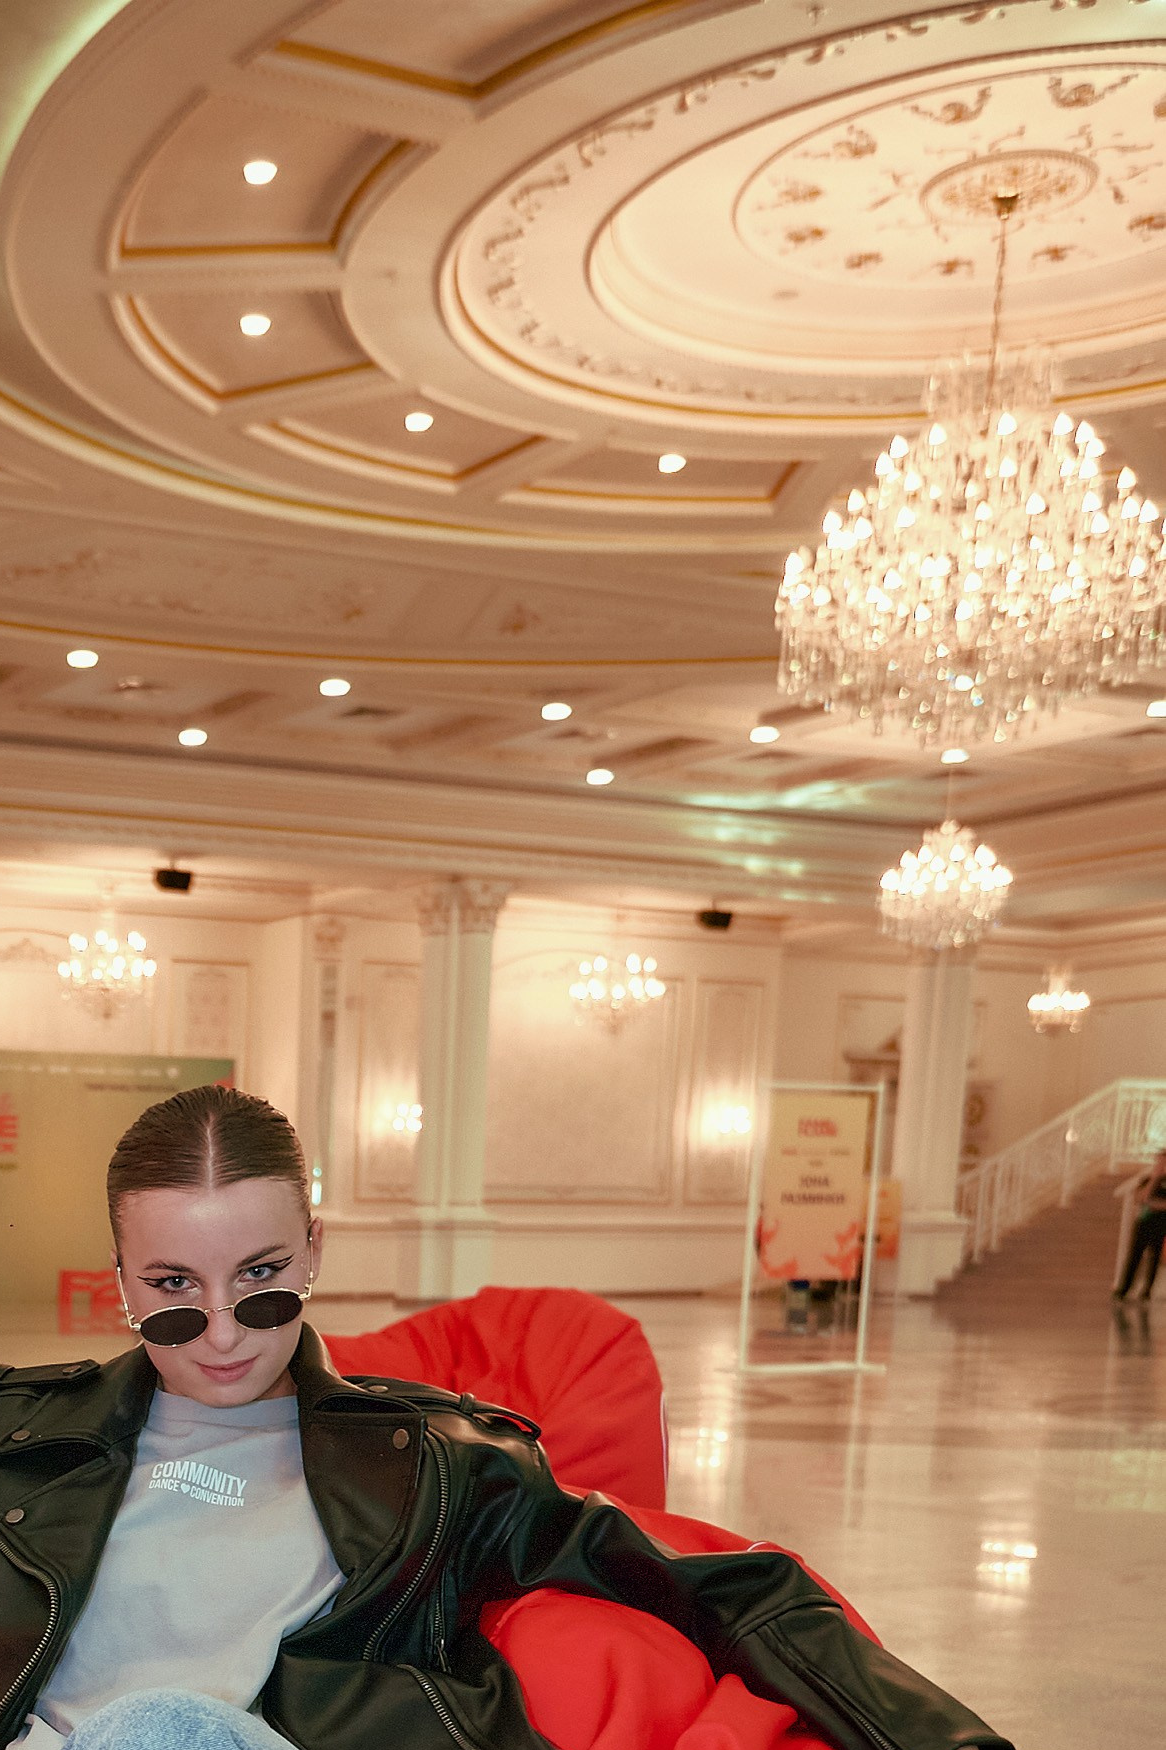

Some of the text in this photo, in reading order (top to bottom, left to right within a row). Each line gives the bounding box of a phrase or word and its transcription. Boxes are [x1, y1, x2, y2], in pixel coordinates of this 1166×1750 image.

[148, 1478, 245, 1508] DANCE CONVENTION
[151, 1460, 248, 1498] COMMUNITY
